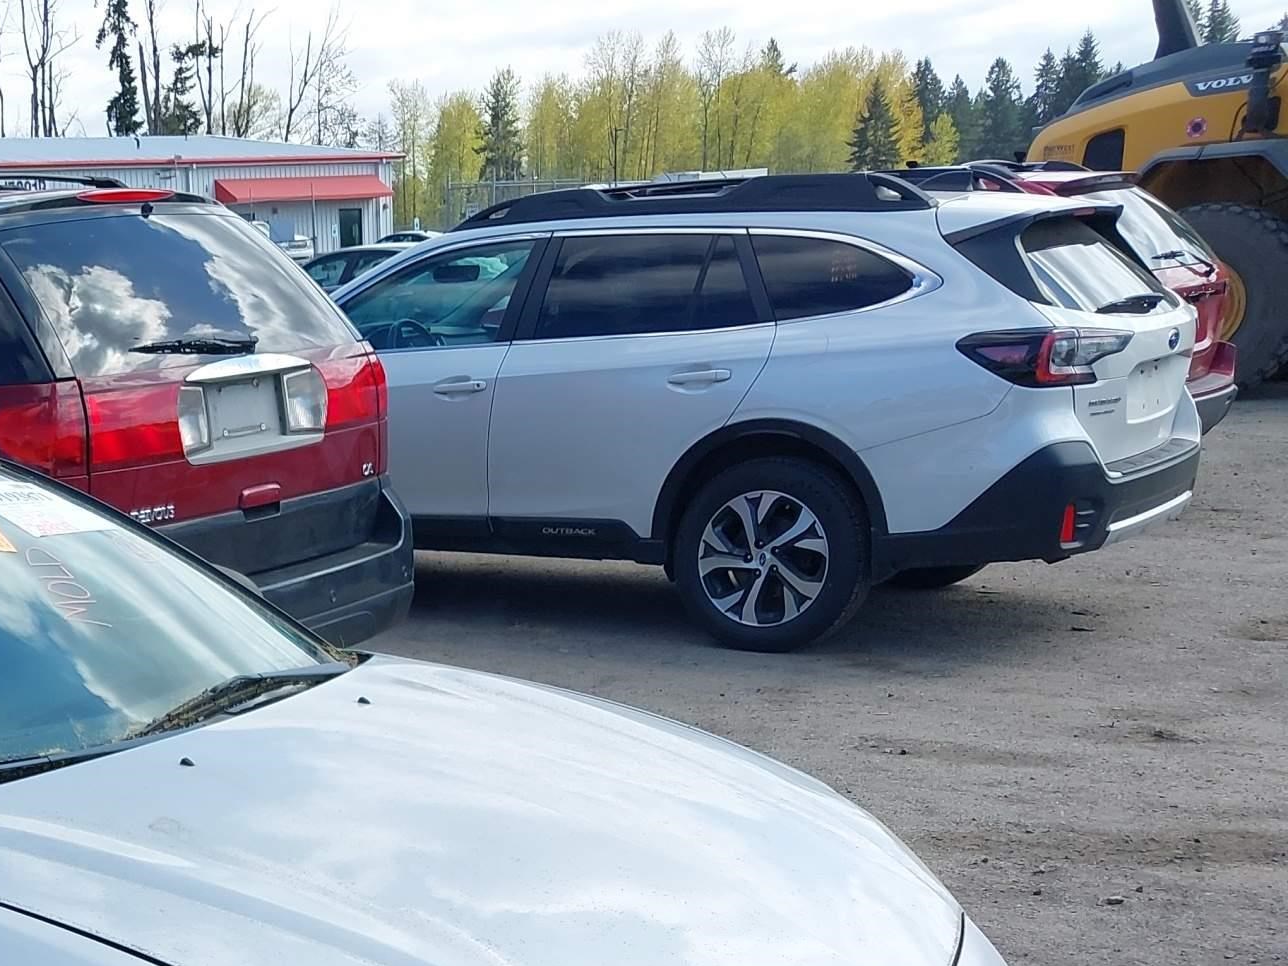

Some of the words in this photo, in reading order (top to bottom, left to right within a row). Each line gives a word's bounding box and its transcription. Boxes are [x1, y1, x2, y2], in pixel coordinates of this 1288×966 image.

[1194, 74, 1254, 91] VOLV
[542, 527, 596, 535] OUTBACK
[24, 547, 113, 628] MOLD
